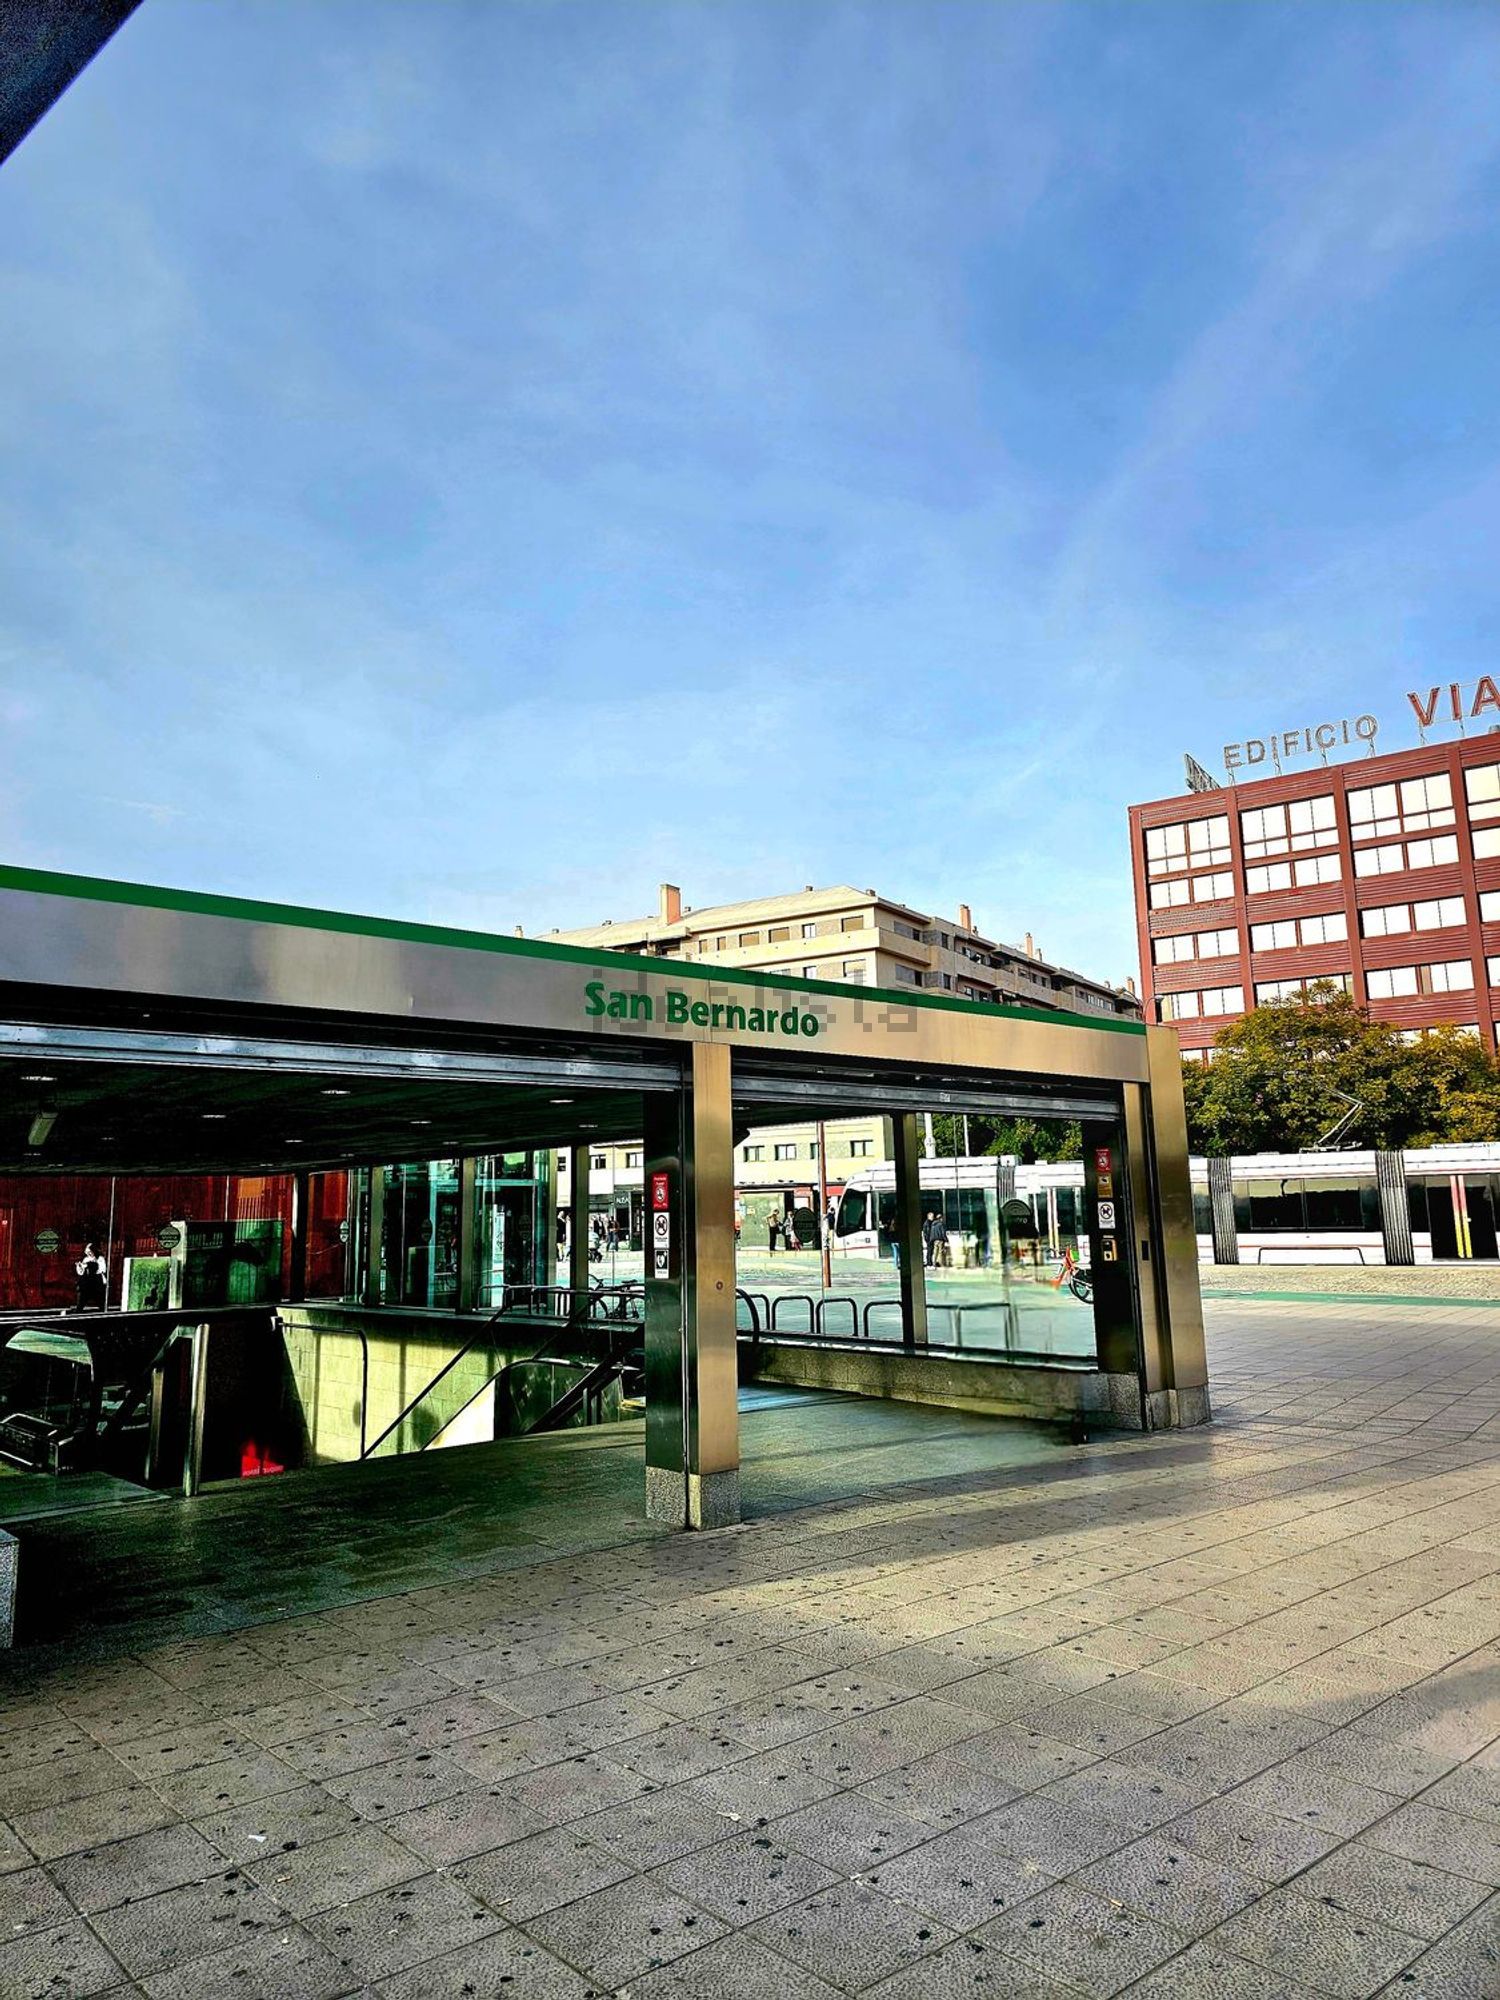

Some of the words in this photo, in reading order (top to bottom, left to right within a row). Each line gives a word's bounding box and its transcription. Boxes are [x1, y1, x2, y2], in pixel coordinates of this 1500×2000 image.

[1224, 715, 1377, 769] EDIFICIO
[1407, 675, 1500, 727] VIA
[584, 981, 653, 1020] San
[666, 991, 819, 1037] Bernardo
